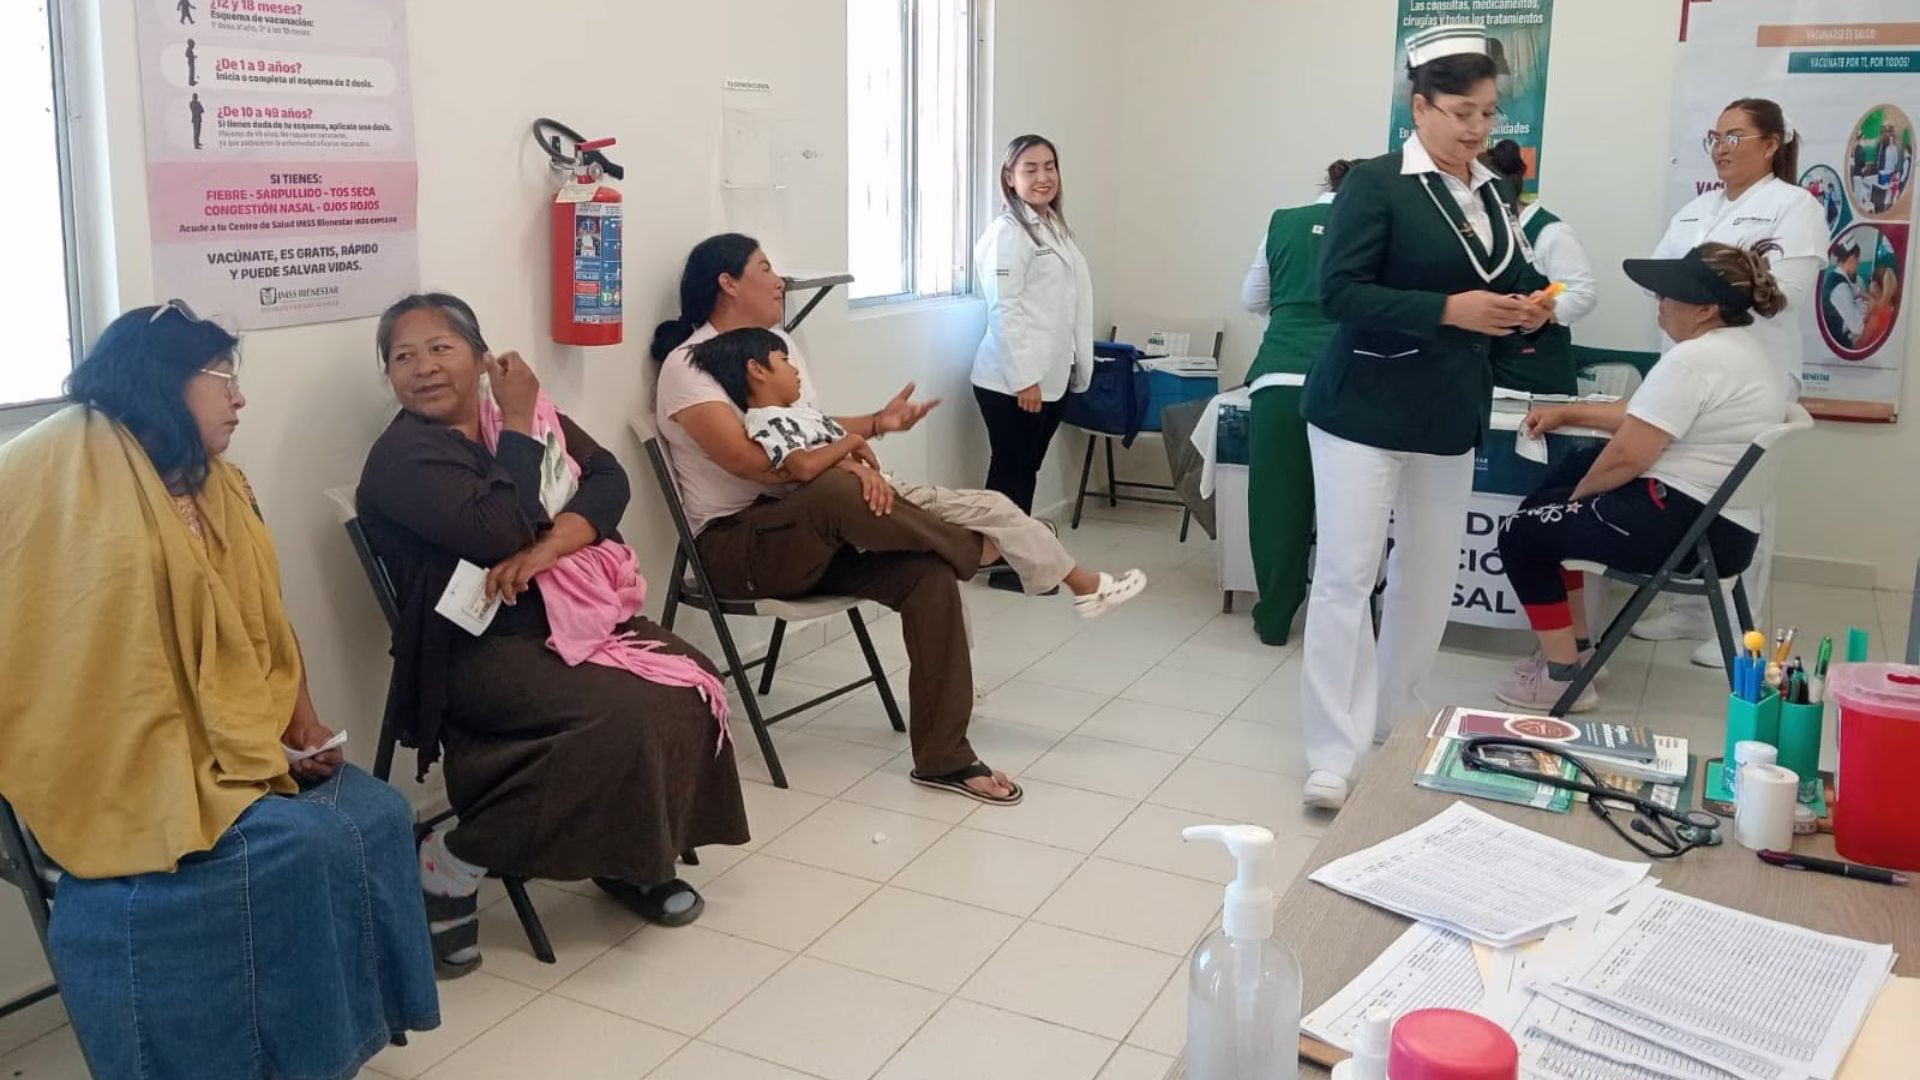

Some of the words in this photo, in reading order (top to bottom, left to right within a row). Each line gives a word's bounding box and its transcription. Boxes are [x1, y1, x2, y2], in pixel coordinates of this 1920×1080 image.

[232, 0, 239, 12] y
[241, 0, 254, 11] 18
[258, 3, 303, 15] meses?
[1410, 0, 1425, 11] Las
[211, 10, 250, 21] Esquema
[252, 14, 264, 22] de
[265, 16, 314, 27] vacunación:
[1403, 13, 1437, 28] cirugías
[1487, 12, 1543, 25] tratamientos
[216, 58, 238, 71] ¿De
[247, 62, 255, 71] a
[257, 60, 266, 72] 9
[268, 61, 303, 74] años?
[1846, 56, 1860, 68] POR
[1870, 56, 1884, 68] POR
[1885, 56, 1911, 68] TODOS!
[216, 72, 240, 82] Inicia
[248, 74, 287, 85] completa
[298, 78, 333, 87] esquema
[217, 106, 238, 119] ¿De
[241, 107, 253, 118] 10
[255, 108, 263, 118] a
[264, 107, 279, 118] 49
[281, 107, 313, 120] años?
[217, 120, 226, 128] Si
[227, 120, 252, 128] tienes
[253, 121, 272, 129] duda
[273, 121, 282, 129] de
[270, 174, 280, 184] SI
[282, 173, 322, 185] TIENES:
[206, 189, 248, 201] FIEBRE
[256, 187, 322, 200] SARPULLIDO
[330, 187, 349, 198] TOS
[350, 186, 376, 197] SECA
[204, 203, 277, 216] CONGESTIÓN
[280, 202, 315, 214] NASAL
[323, 201, 348, 212] OJOS
[349, 200, 380, 211] ROJOS
[179, 224, 209, 233] Acude
[217, 223, 227, 231] tu
[228, 222, 258, 231] Centro
[260, 220, 270, 230] de
[271, 219, 295, 229] Salud
[296, 219, 316, 228] IMSS
[317, 218, 353, 227] Bienestar
[207, 249, 278, 264] VACÚNATE,
[280, 249, 294, 260] ES
[297, 246, 339, 258] GRATIS,
[341, 242, 378, 256] RÁPIDO
[229, 268, 238, 280] Y
[241, 267, 280, 280] PUEDE
[283, 263, 326, 277] SALVAR
[328, 260, 362, 273] VIDAS.
[278, 288, 297, 299] IMSS
